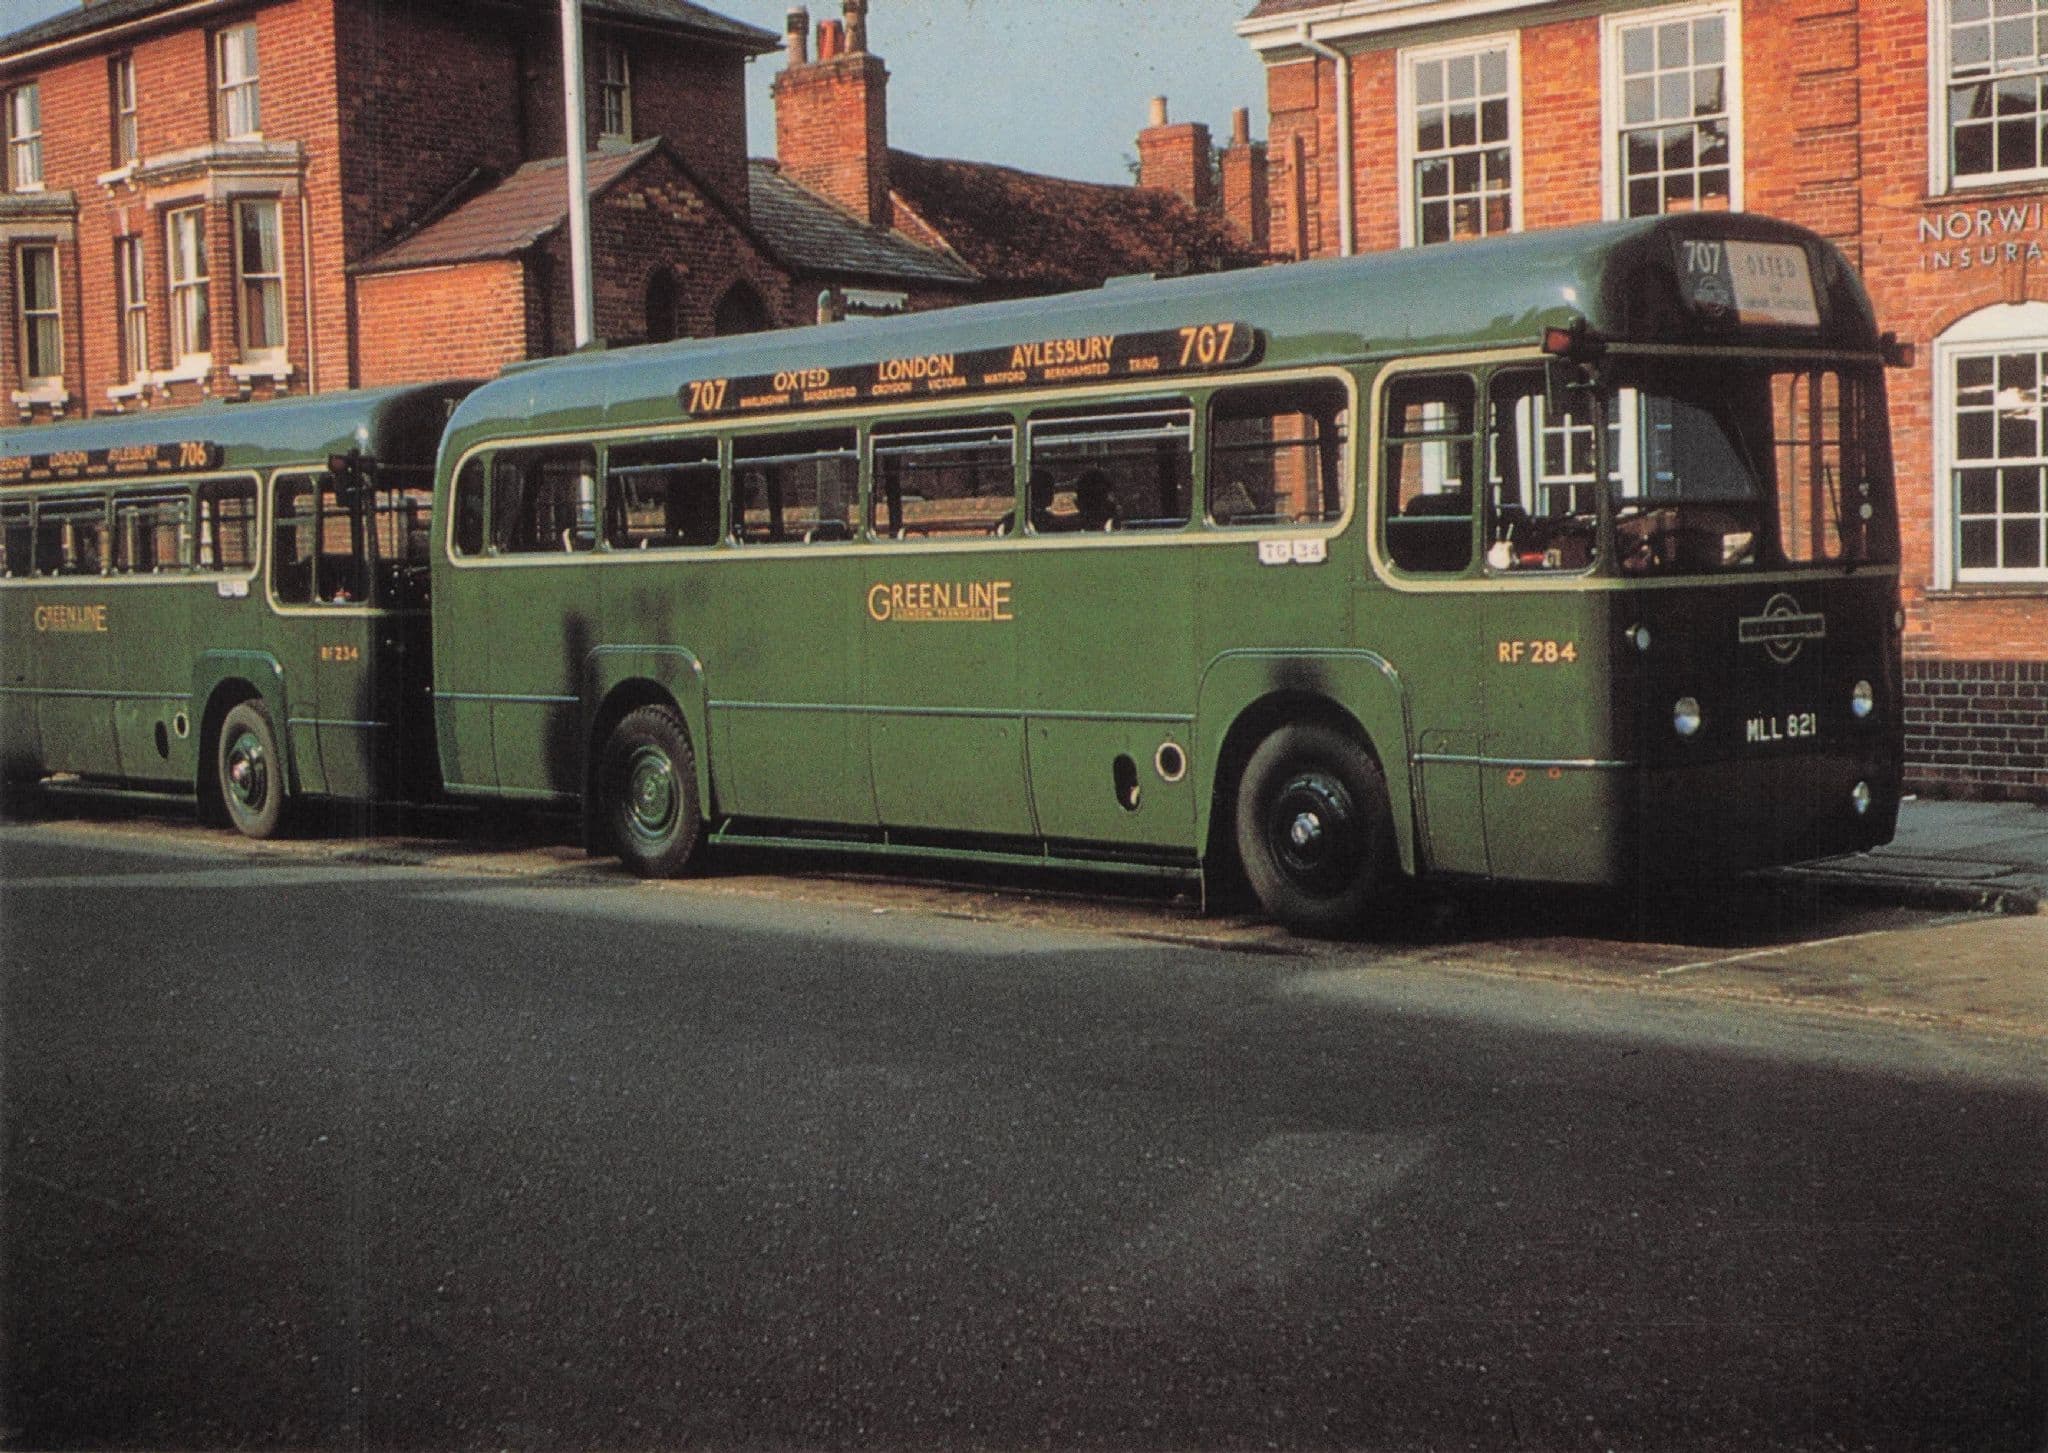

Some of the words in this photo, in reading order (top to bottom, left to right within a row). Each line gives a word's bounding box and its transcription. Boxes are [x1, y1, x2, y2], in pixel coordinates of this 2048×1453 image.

[1918, 203, 2041, 244] NORWI
[1683, 240, 1721, 274] 707
[1919, 241, 2043, 270] INSURA
[1010, 335, 1115, 369] AYLESBURY
[1179, 323, 1236, 367] 707
[773, 368, 830, 391] OXTED
[878, 354, 955, 381] LONDON
[688, 379, 728, 413] 707
[179, 441, 207, 467] 706
[867, 582, 951, 621] GREEN
[955, 580, 1014, 620] LINE
[1498, 640, 1525, 663] RF
[1530, 640, 1578, 663] 284
[1746, 716, 1784, 743] MLL
[1787, 712, 1817, 737] 821
